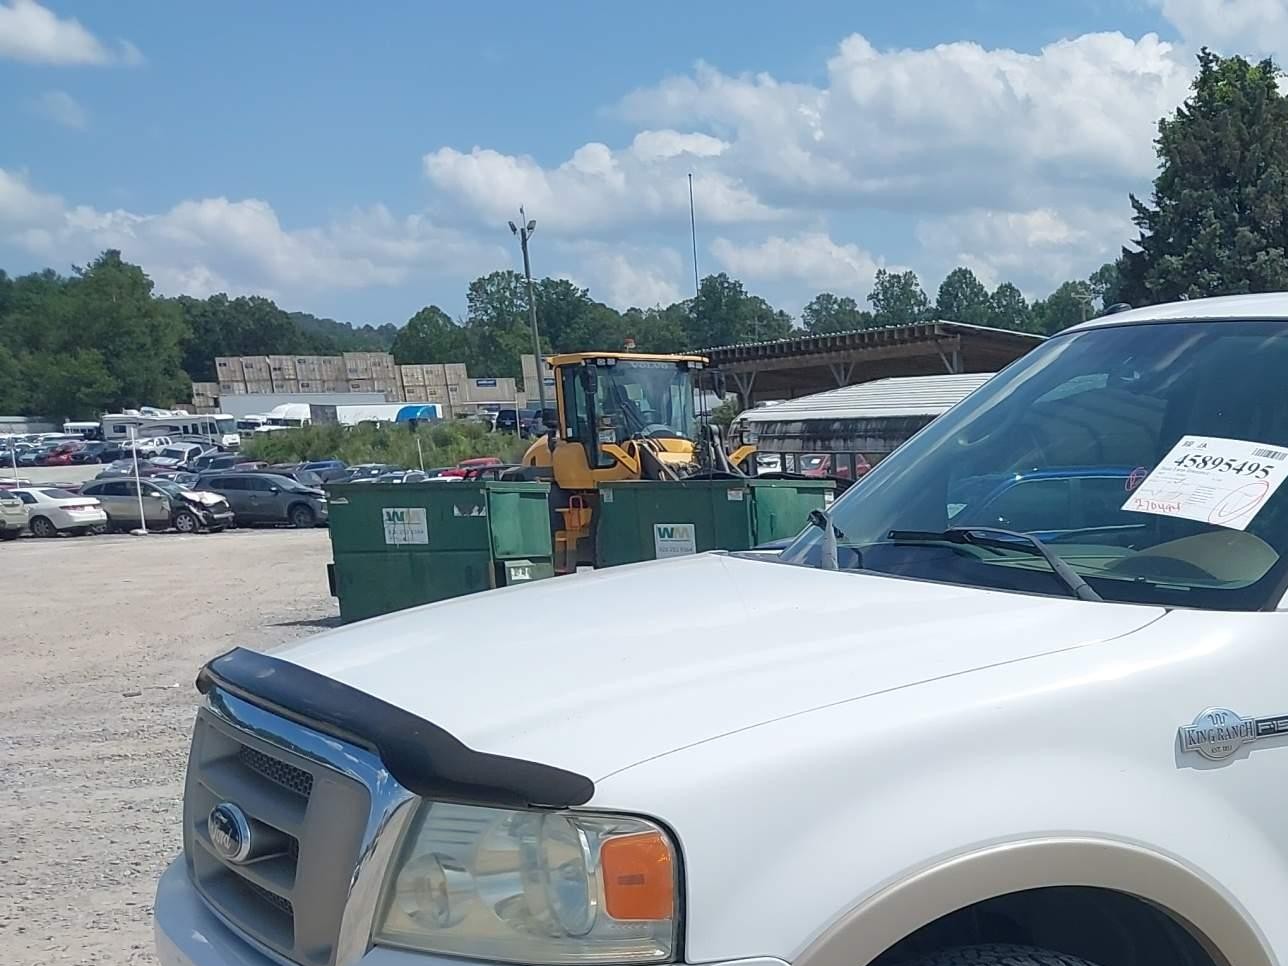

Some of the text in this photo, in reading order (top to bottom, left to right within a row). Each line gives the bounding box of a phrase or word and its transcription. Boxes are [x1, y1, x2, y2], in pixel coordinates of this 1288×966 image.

[1174, 453, 1275, 479] 45895495
[658, 527, 690, 539] WM
[1186, 726, 1215, 746] KING
[1217, 720, 1254, 741] RANCH
